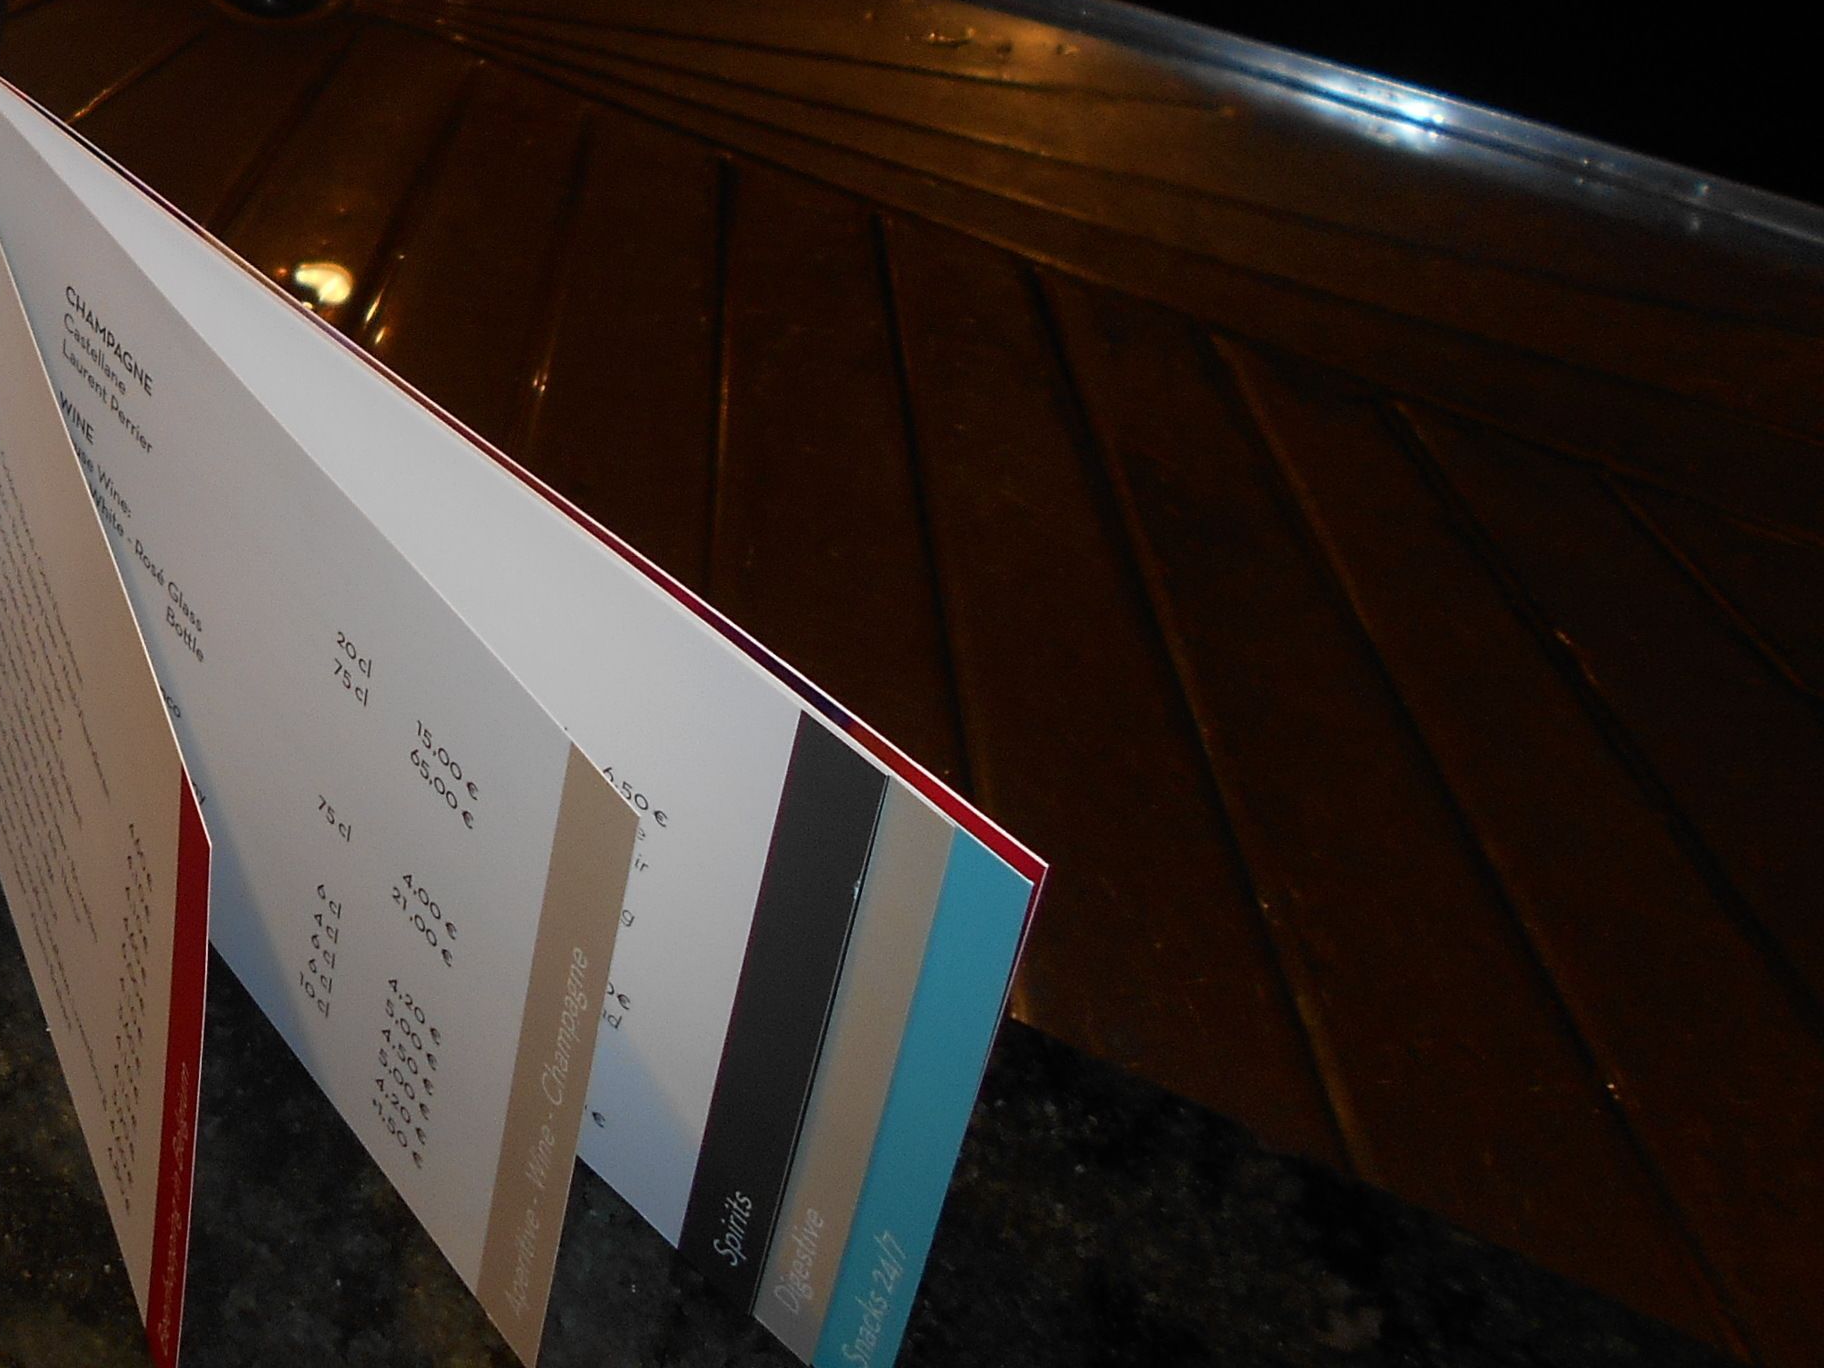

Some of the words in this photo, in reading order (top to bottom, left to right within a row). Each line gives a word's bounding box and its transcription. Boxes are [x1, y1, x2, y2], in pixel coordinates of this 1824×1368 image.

[63, 313, 127, 396] Castellane
[65, 285, 154, 397] CHAMPAGNE
[59, 390, 95, 446] WINE
[62, 338, 108, 404] Laurent
[110, 397, 154, 455] Perrier
[97, 464, 132, 518] Wine:
[89, 486, 125, 536] White
[134, 539, 165, 586] Rosé
[168, 581, 203, 633] Glass
[166, 606, 205, 663] Bottle
[336, 631, 357, 660] 20
[334, 658, 351, 690] 75
[318, 794, 335, 825] 75
[653, 809, 669, 828] €
[317, 884, 326, 900] 6
[311, 934, 320, 950] 6
[314, 913, 323, 927] 4
[300, 971, 316, 999] 10
[308, 958, 317, 974] 6
[526, 1124, 555, 1189] Wine
[542, 947, 589, 1106] Champagne
[713, 1190, 752, 1267] Spirits
[773, 1208, 825, 1315] Digestive
[841, 1289, 888, 1368] Snacks
[872, 1230, 906, 1296] 24/7
